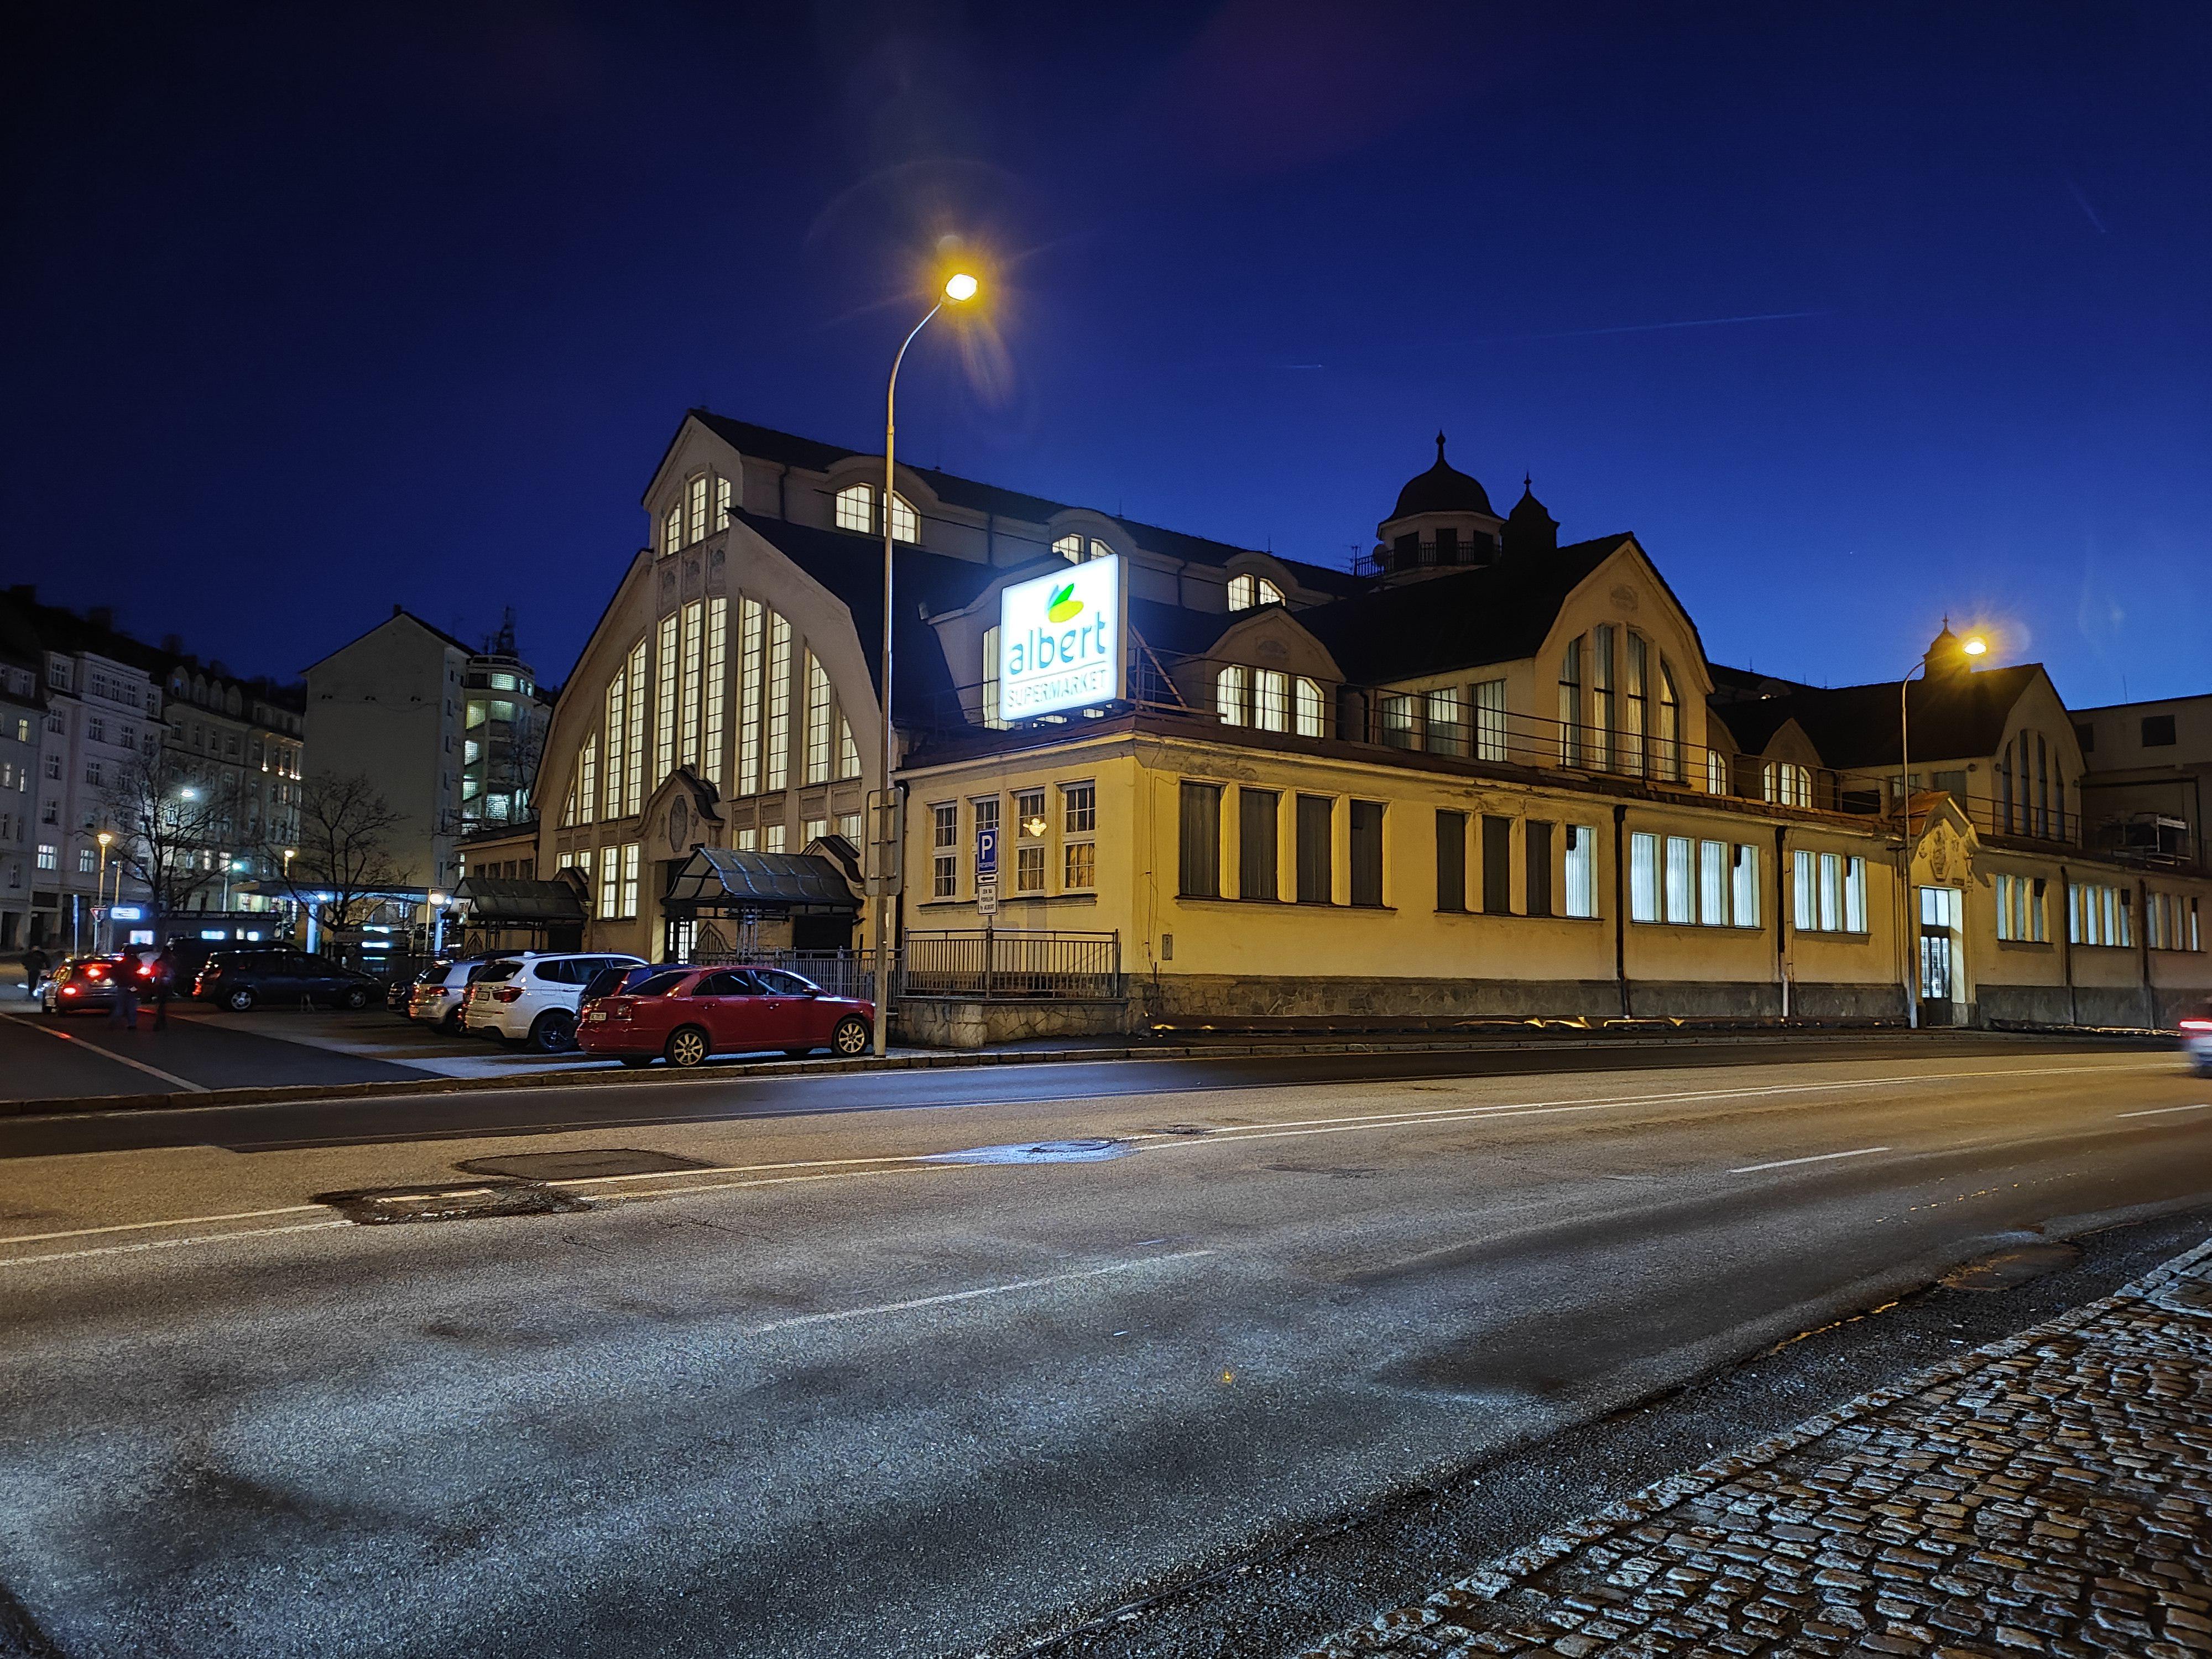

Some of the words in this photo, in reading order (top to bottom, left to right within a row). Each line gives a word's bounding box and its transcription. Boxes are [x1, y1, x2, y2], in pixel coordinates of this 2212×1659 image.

[1009, 611, 1106, 675] albert
[1008, 670, 1107, 707] SUPERMARKET
[981, 835, 993, 859] P
